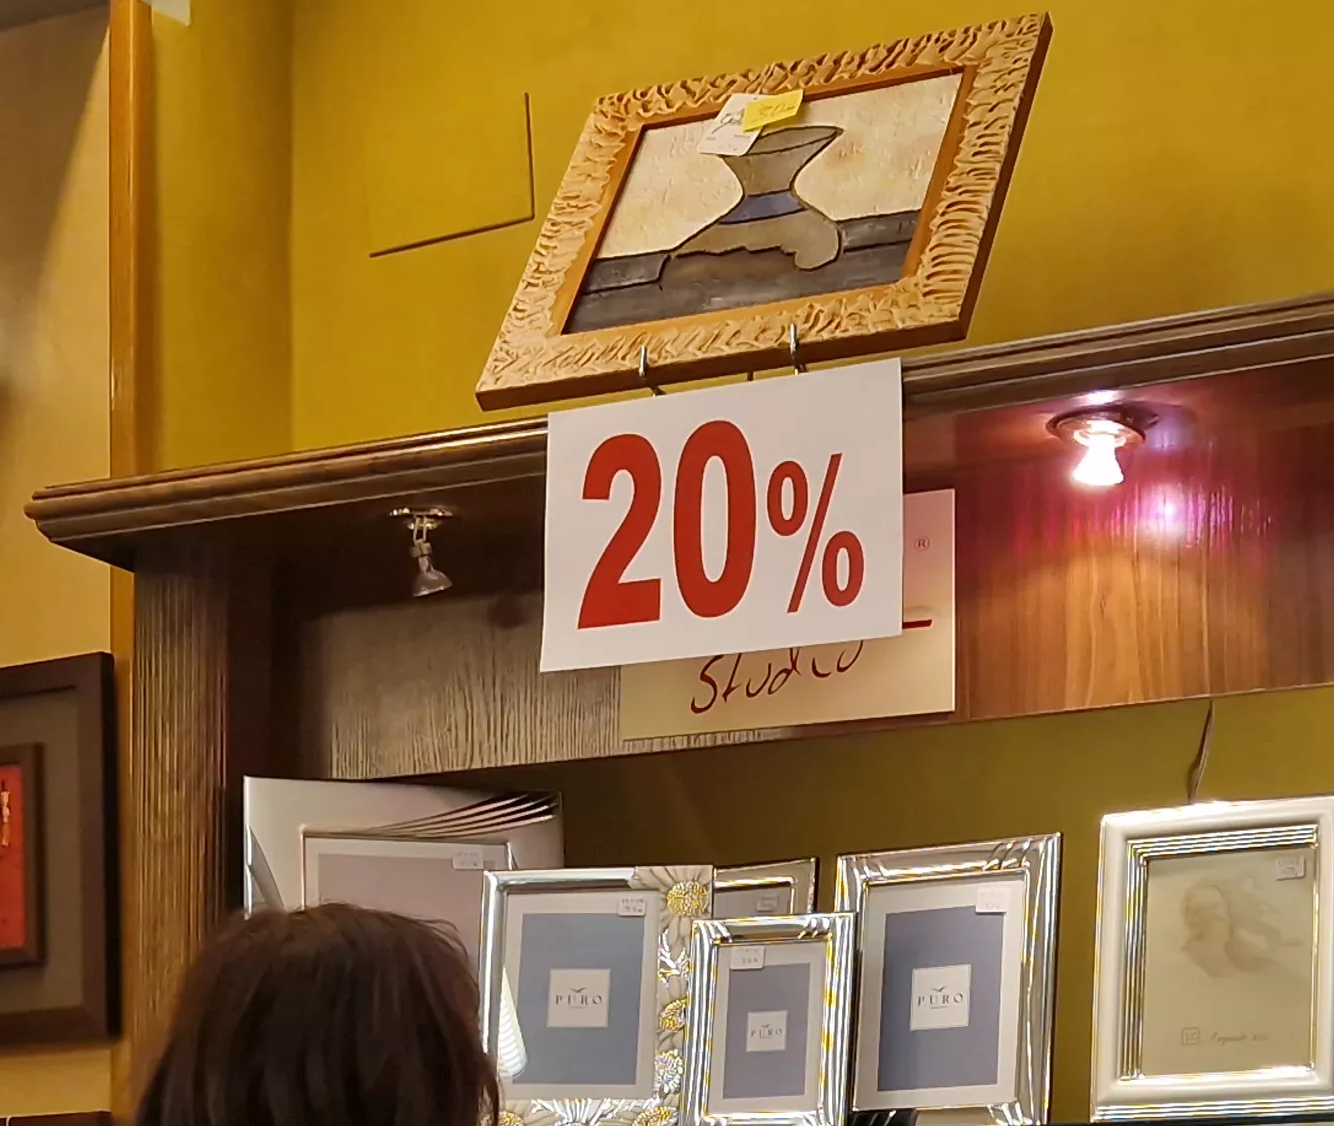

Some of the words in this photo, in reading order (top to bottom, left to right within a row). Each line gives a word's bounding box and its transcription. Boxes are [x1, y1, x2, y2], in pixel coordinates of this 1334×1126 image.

[577, 420, 865, 630] 20%
[555, 994, 603, 1006] PURO
[916, 993, 964, 1008] PURO
